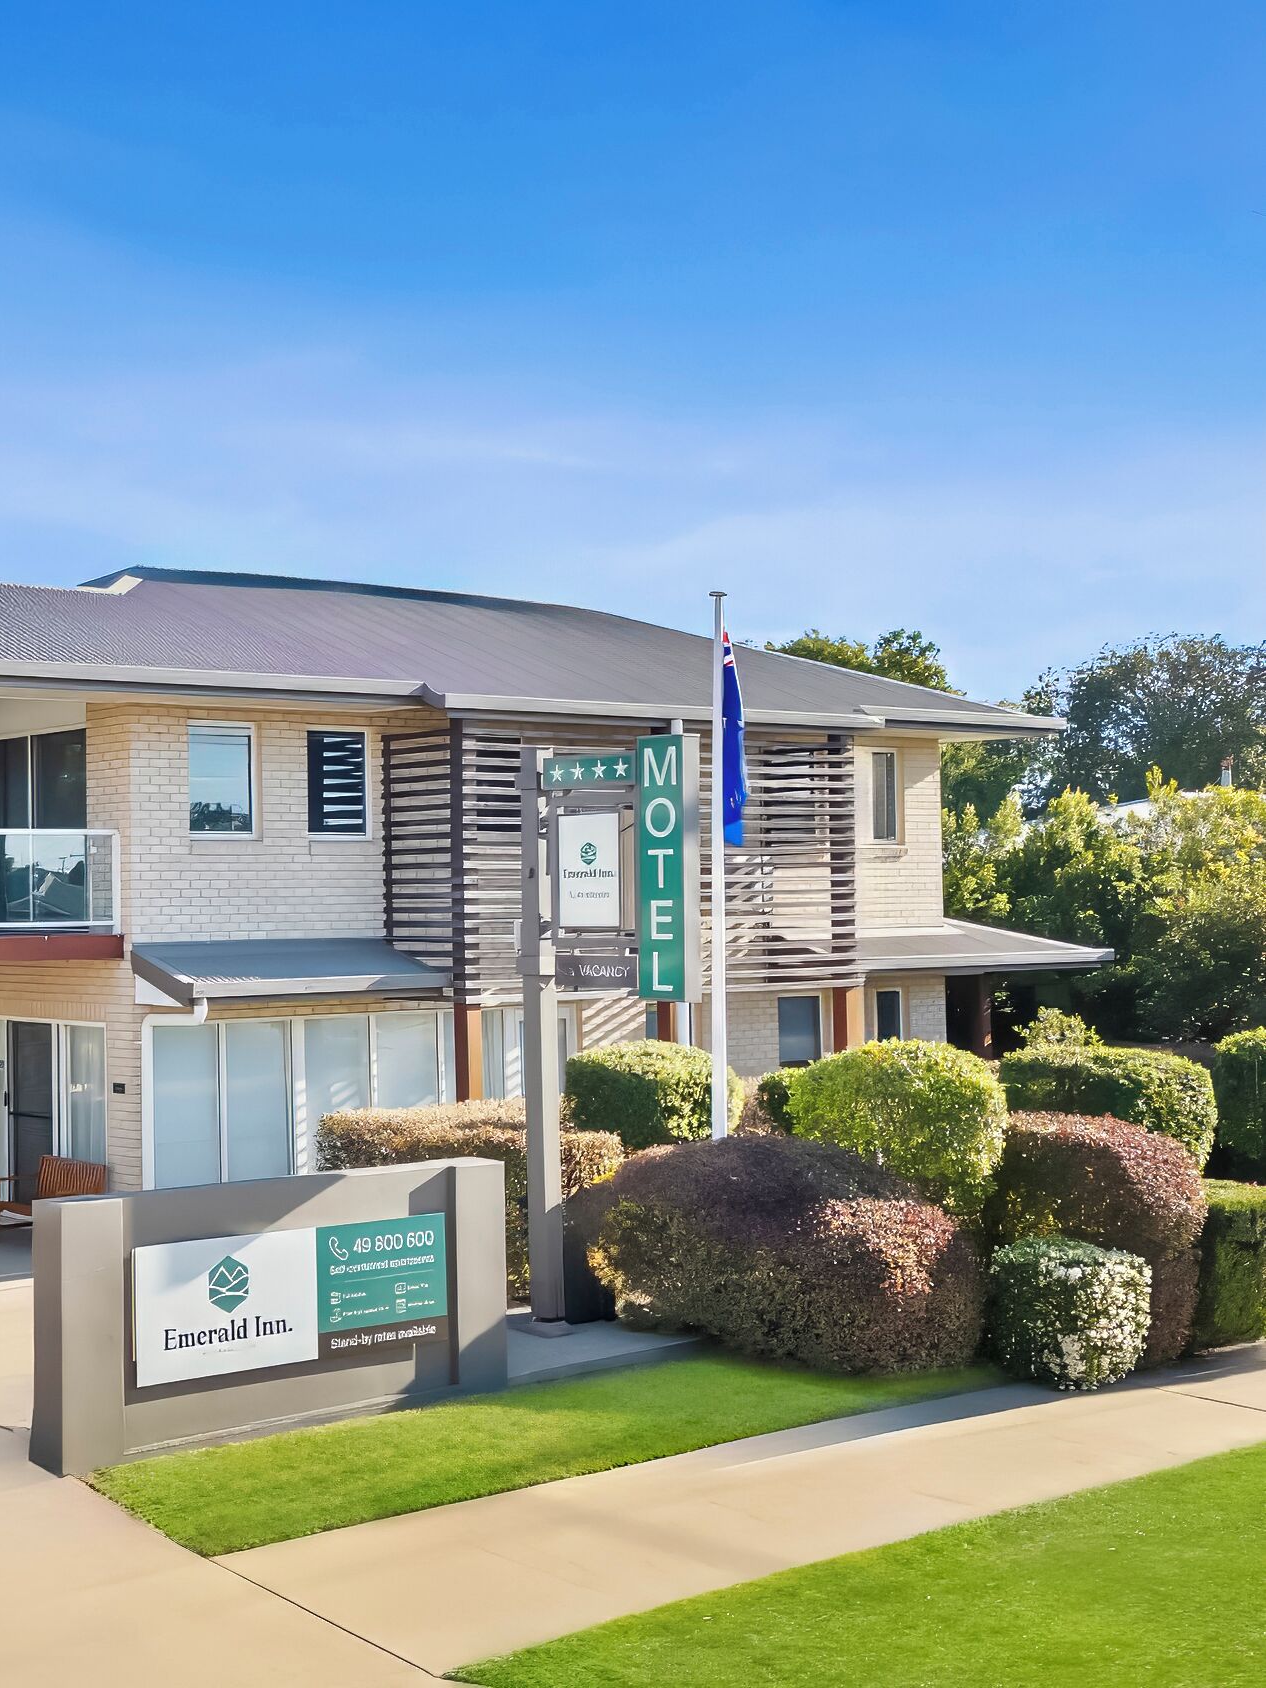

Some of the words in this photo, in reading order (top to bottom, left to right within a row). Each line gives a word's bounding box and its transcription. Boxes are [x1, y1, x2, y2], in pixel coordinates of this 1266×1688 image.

[643, 746, 677, 992] MOTEL
[579, 964, 631, 977] VACANCY
[353, 1237, 372, 1253] 49
[406, 1230, 435, 1248] 600
[163, 1317, 248, 1351] Emerald
[255, 1315, 293, 1338] Inn.
